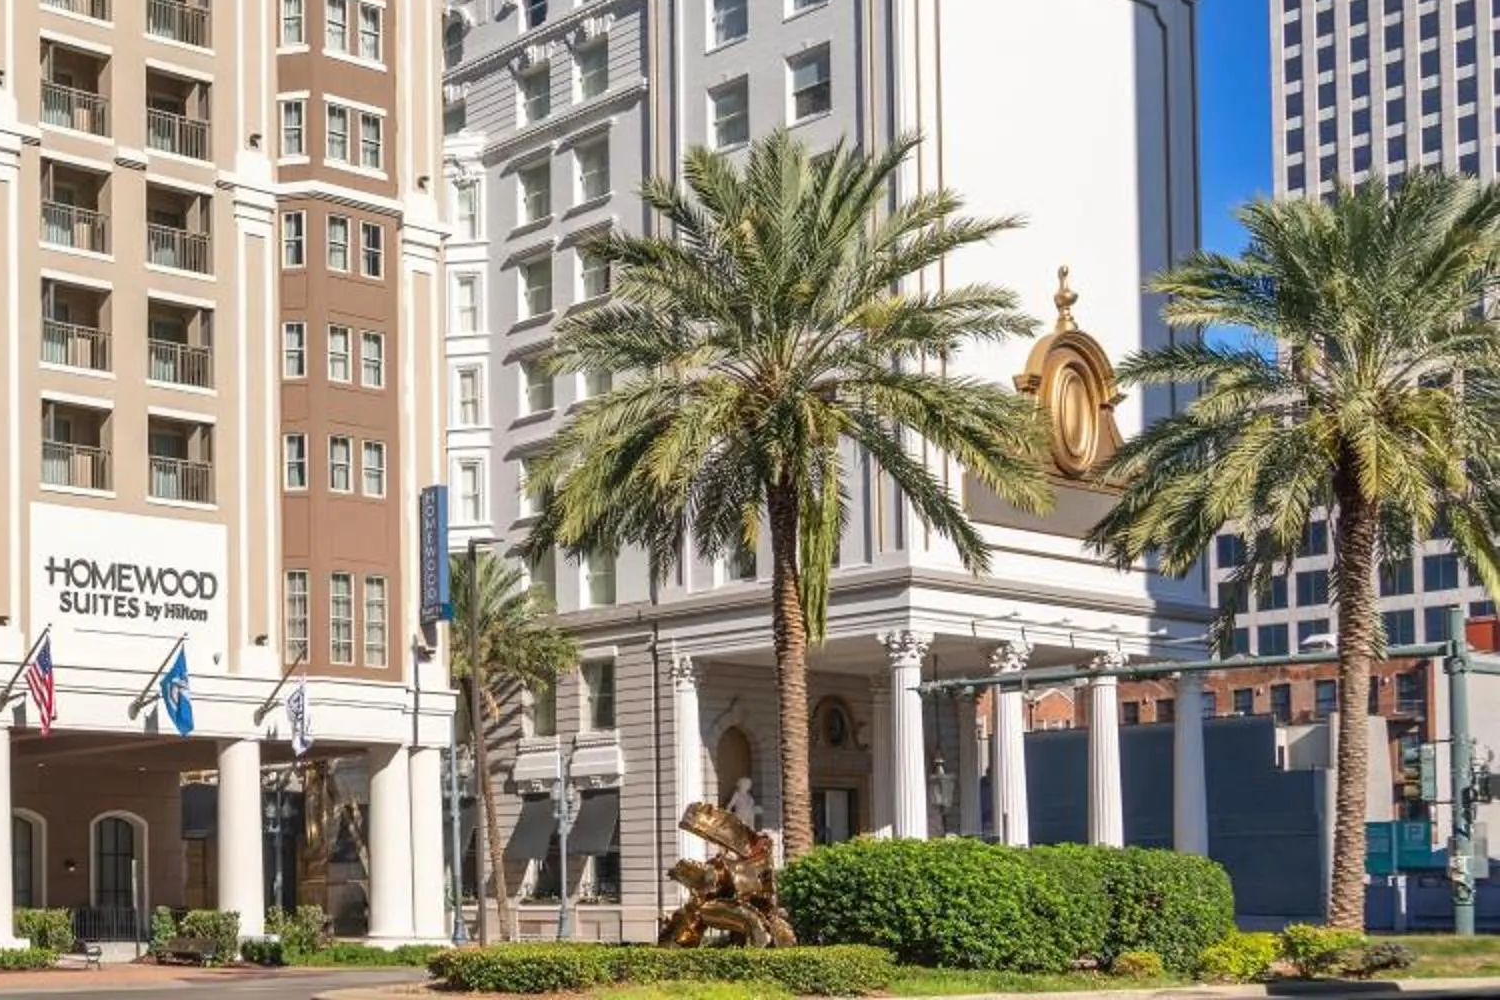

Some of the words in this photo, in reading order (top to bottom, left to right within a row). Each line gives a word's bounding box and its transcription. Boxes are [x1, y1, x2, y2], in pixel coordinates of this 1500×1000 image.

[44, 556, 218, 600] HOMEWOOD
[59, 590, 140, 618] SUITES
[145, 601, 163, 621] by
[164, 603, 208, 622] Hilton
